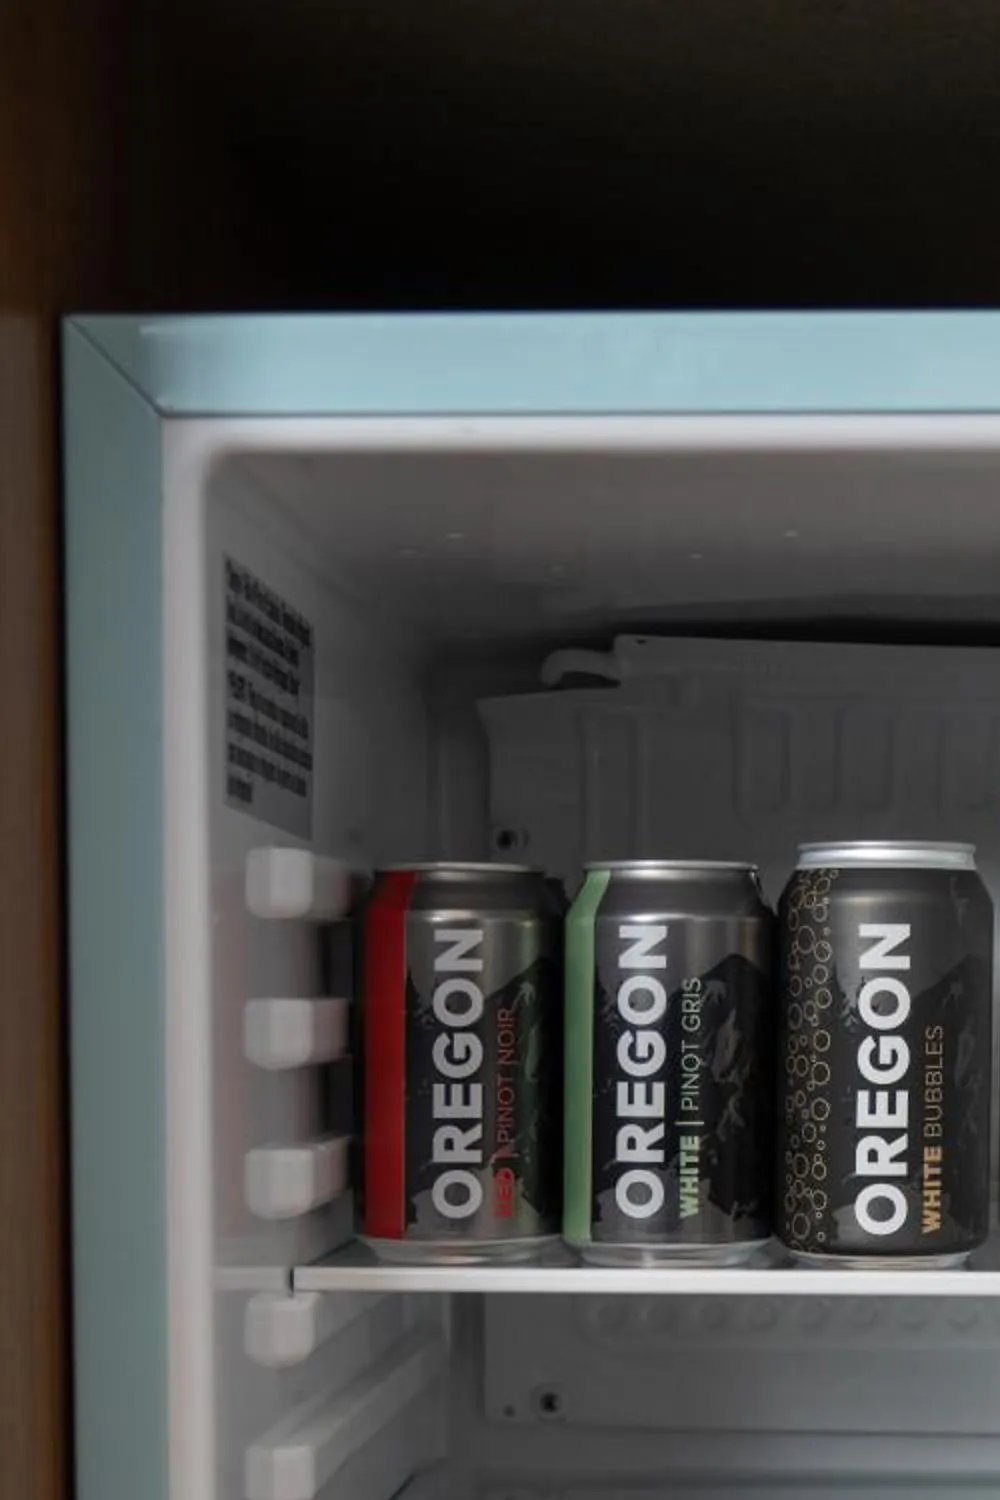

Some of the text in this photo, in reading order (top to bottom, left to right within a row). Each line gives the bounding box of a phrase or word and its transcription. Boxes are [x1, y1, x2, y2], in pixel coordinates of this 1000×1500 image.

[432, 928, 484, 1219] OREGON
[496, 1006, 516, 1066] NOIR
[496, 1070, 516, 1144] PINOT
[615, 925, 668, 1219] OREGON
[679, 976, 703, 1219] WHITE PINOT GRIS
[854, 922, 912, 1236] OREGON
[920, 1024, 944, 1235] WHITE BUBBLES
